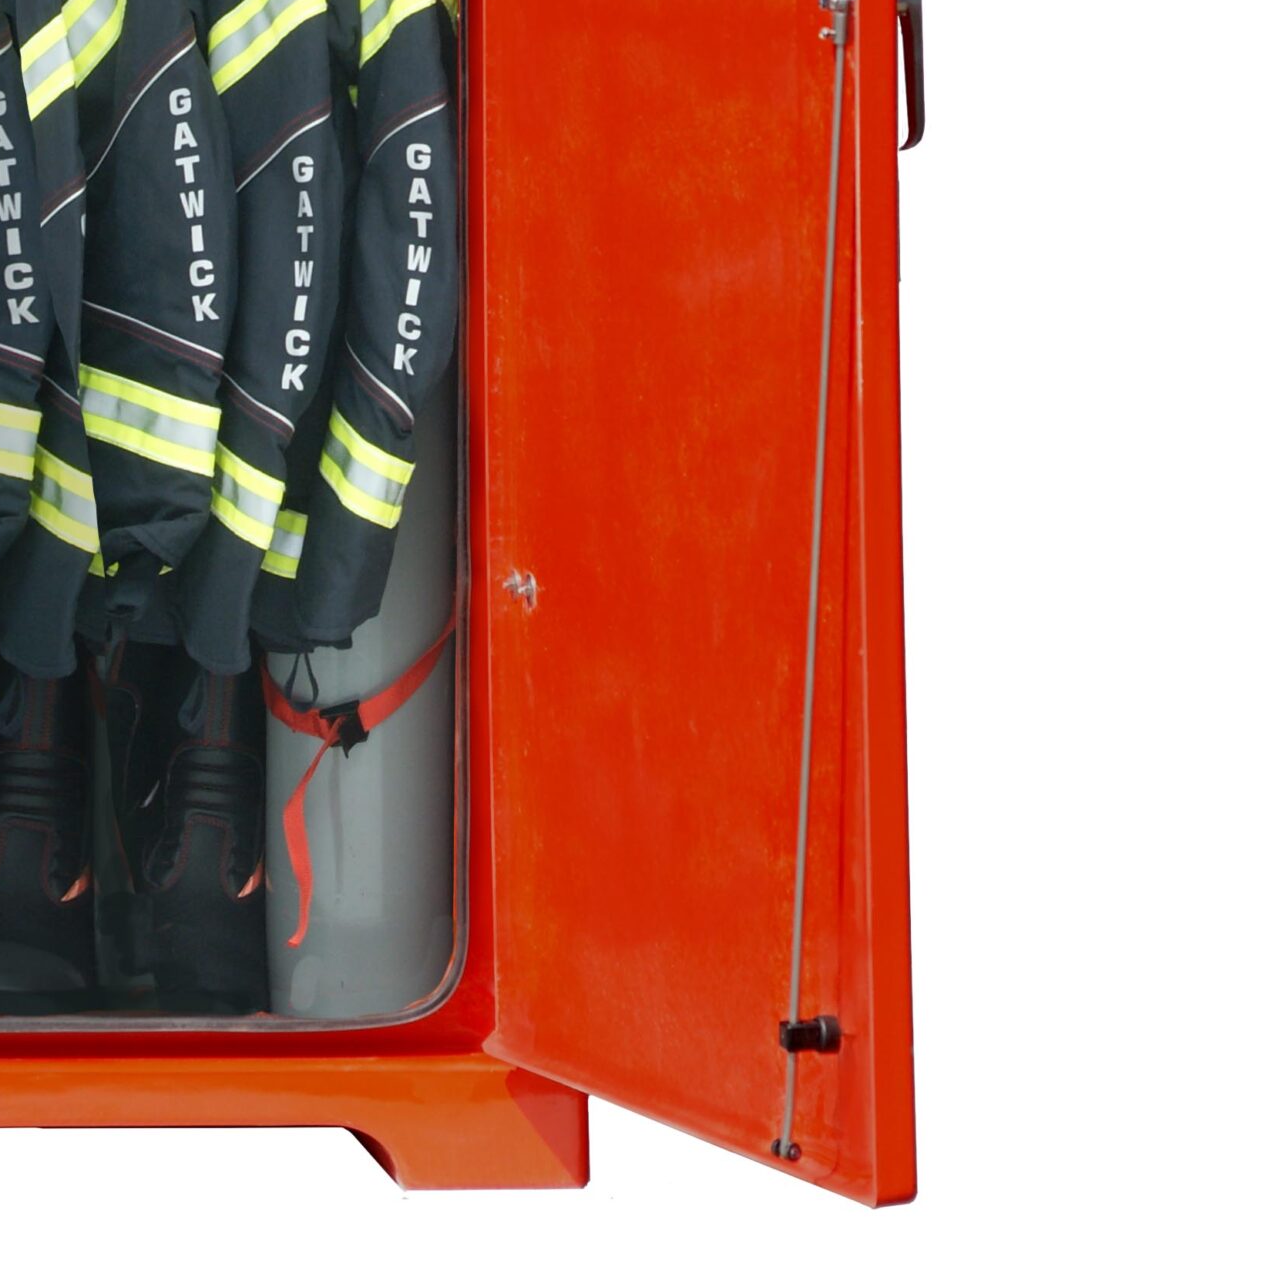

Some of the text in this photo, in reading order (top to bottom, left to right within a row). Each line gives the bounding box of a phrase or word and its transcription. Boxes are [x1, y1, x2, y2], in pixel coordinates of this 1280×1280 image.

[168, 87, 220, 322] GATWICK
[281, 155, 315, 391] GATWICK
[393, 143, 432, 376] GATWICK
